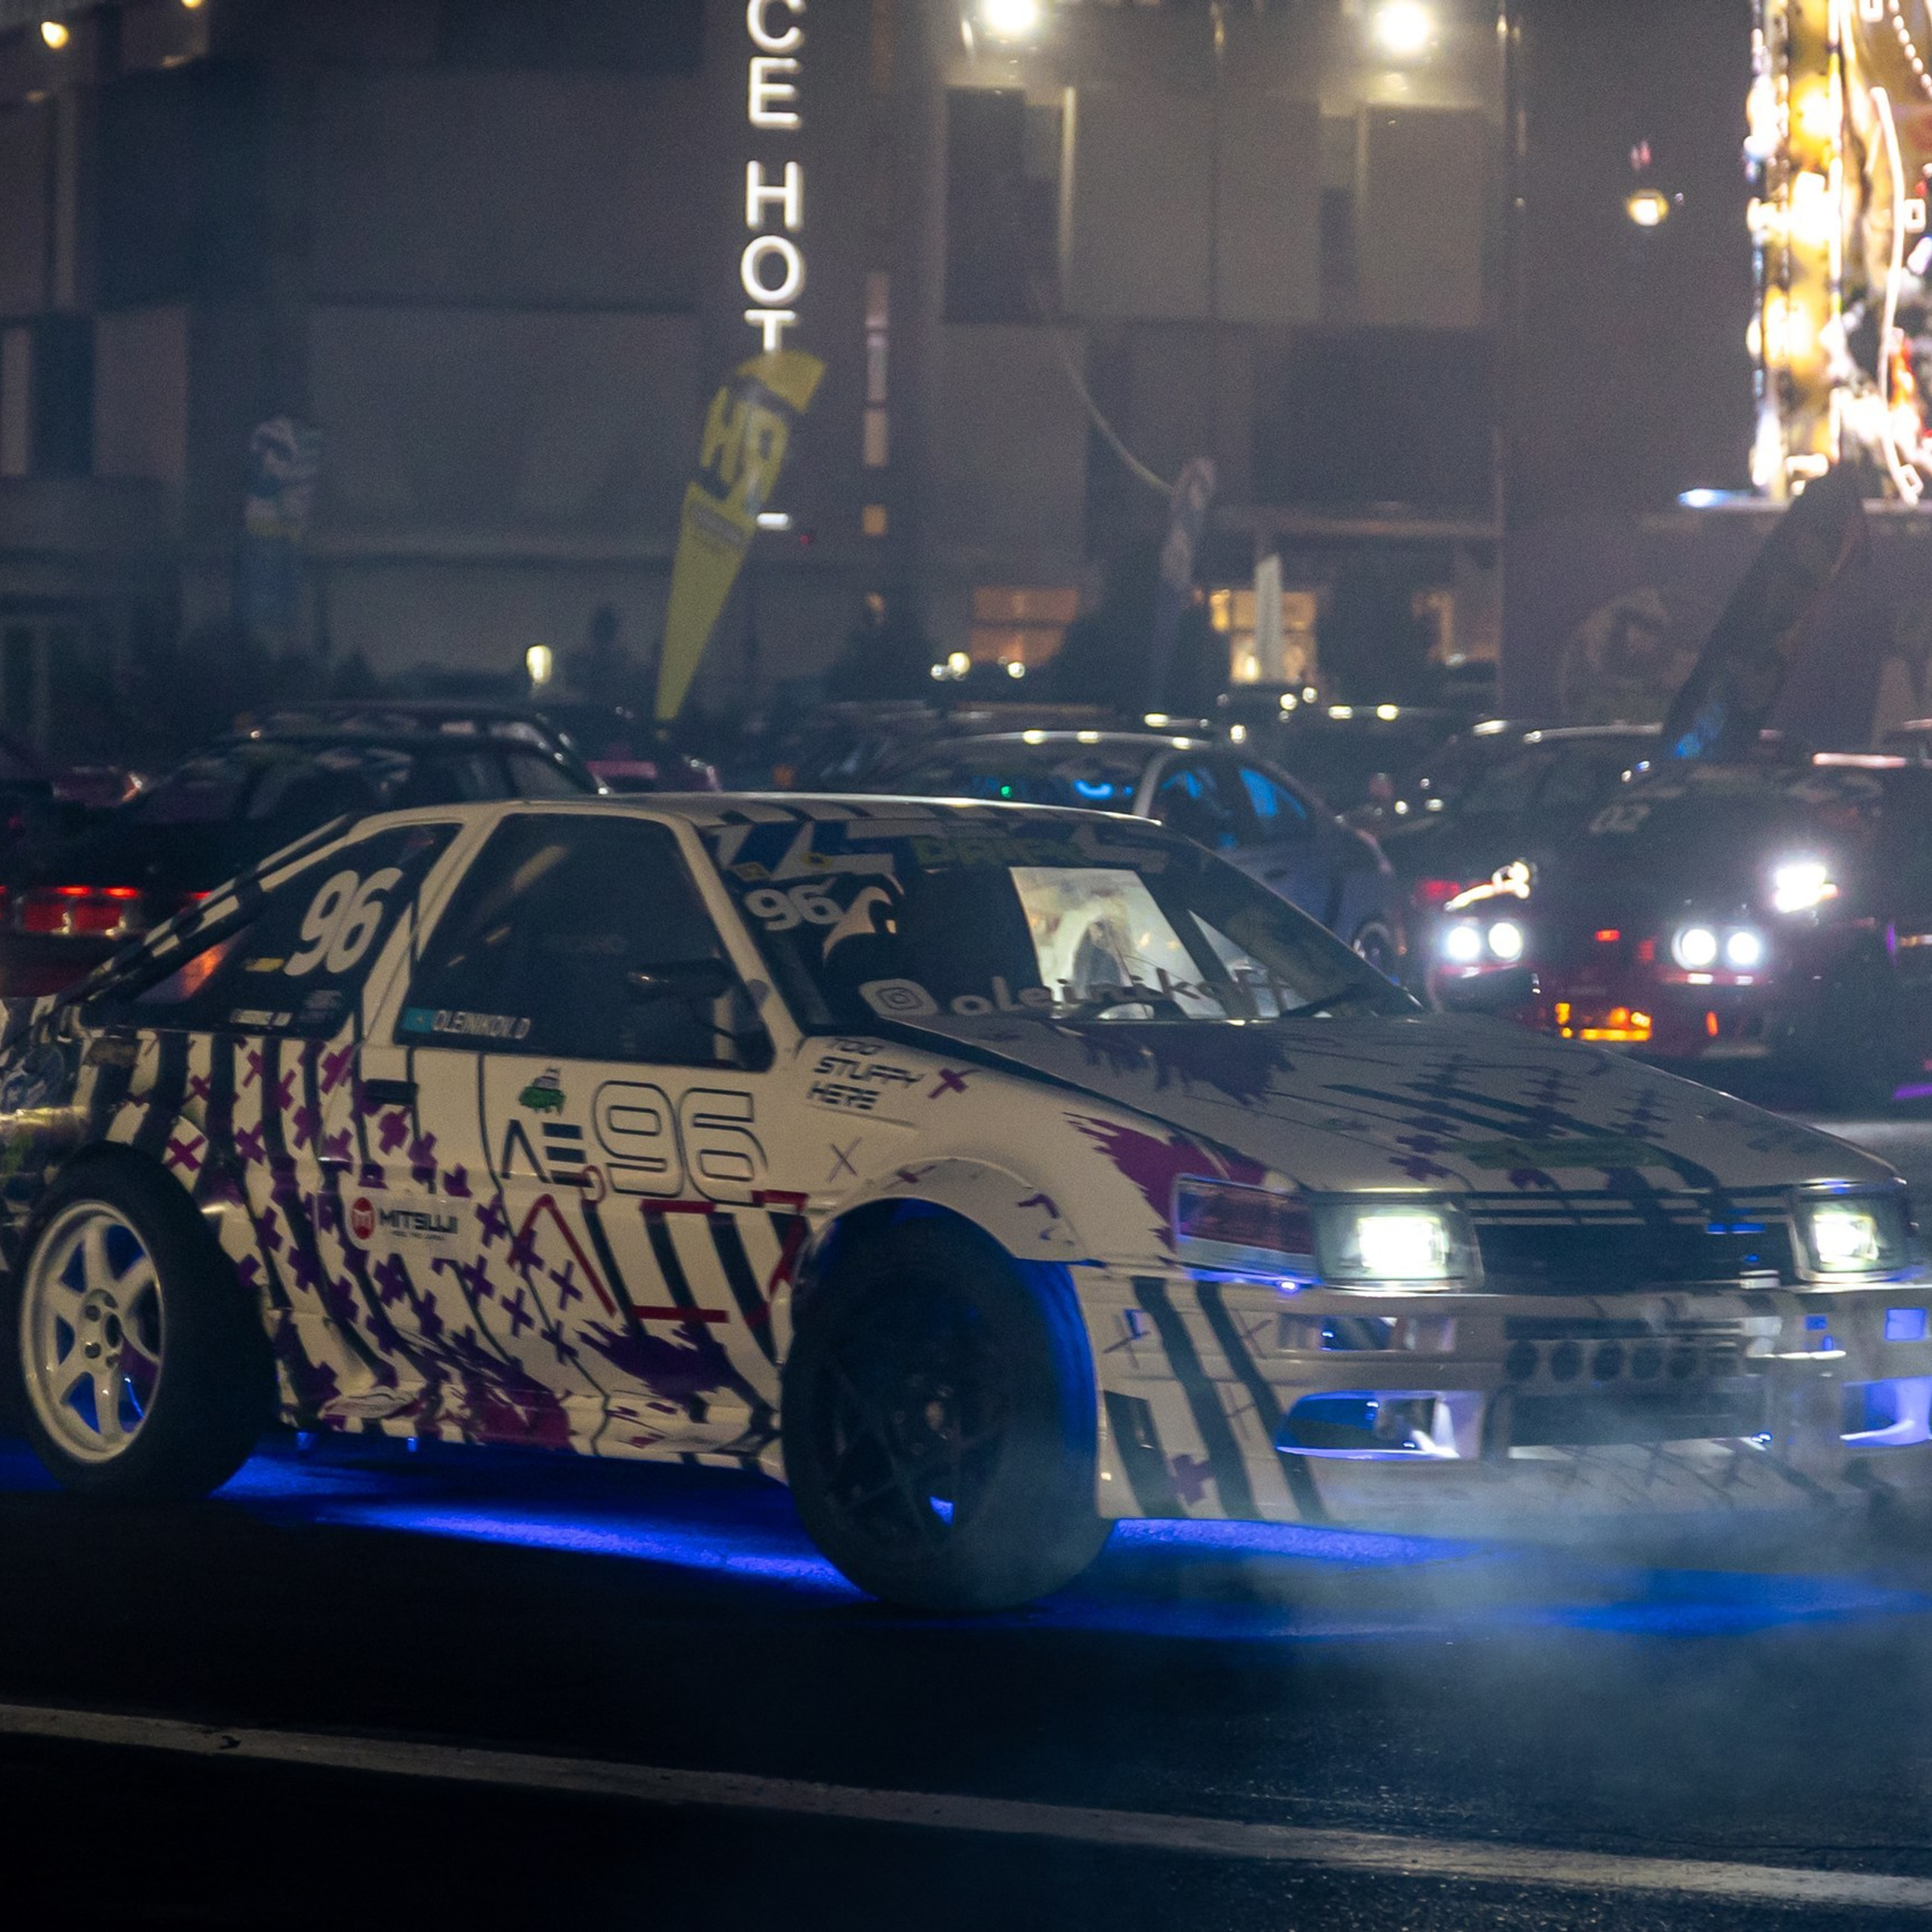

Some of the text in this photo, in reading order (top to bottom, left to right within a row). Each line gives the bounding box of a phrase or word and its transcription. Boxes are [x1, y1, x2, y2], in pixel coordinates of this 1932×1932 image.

[283, 866, 405, 977] 96
[744, 878, 844, 931] 96
[812, 1056, 926, 1089] STUFFY
[806, 1080, 881, 1110] HERE
